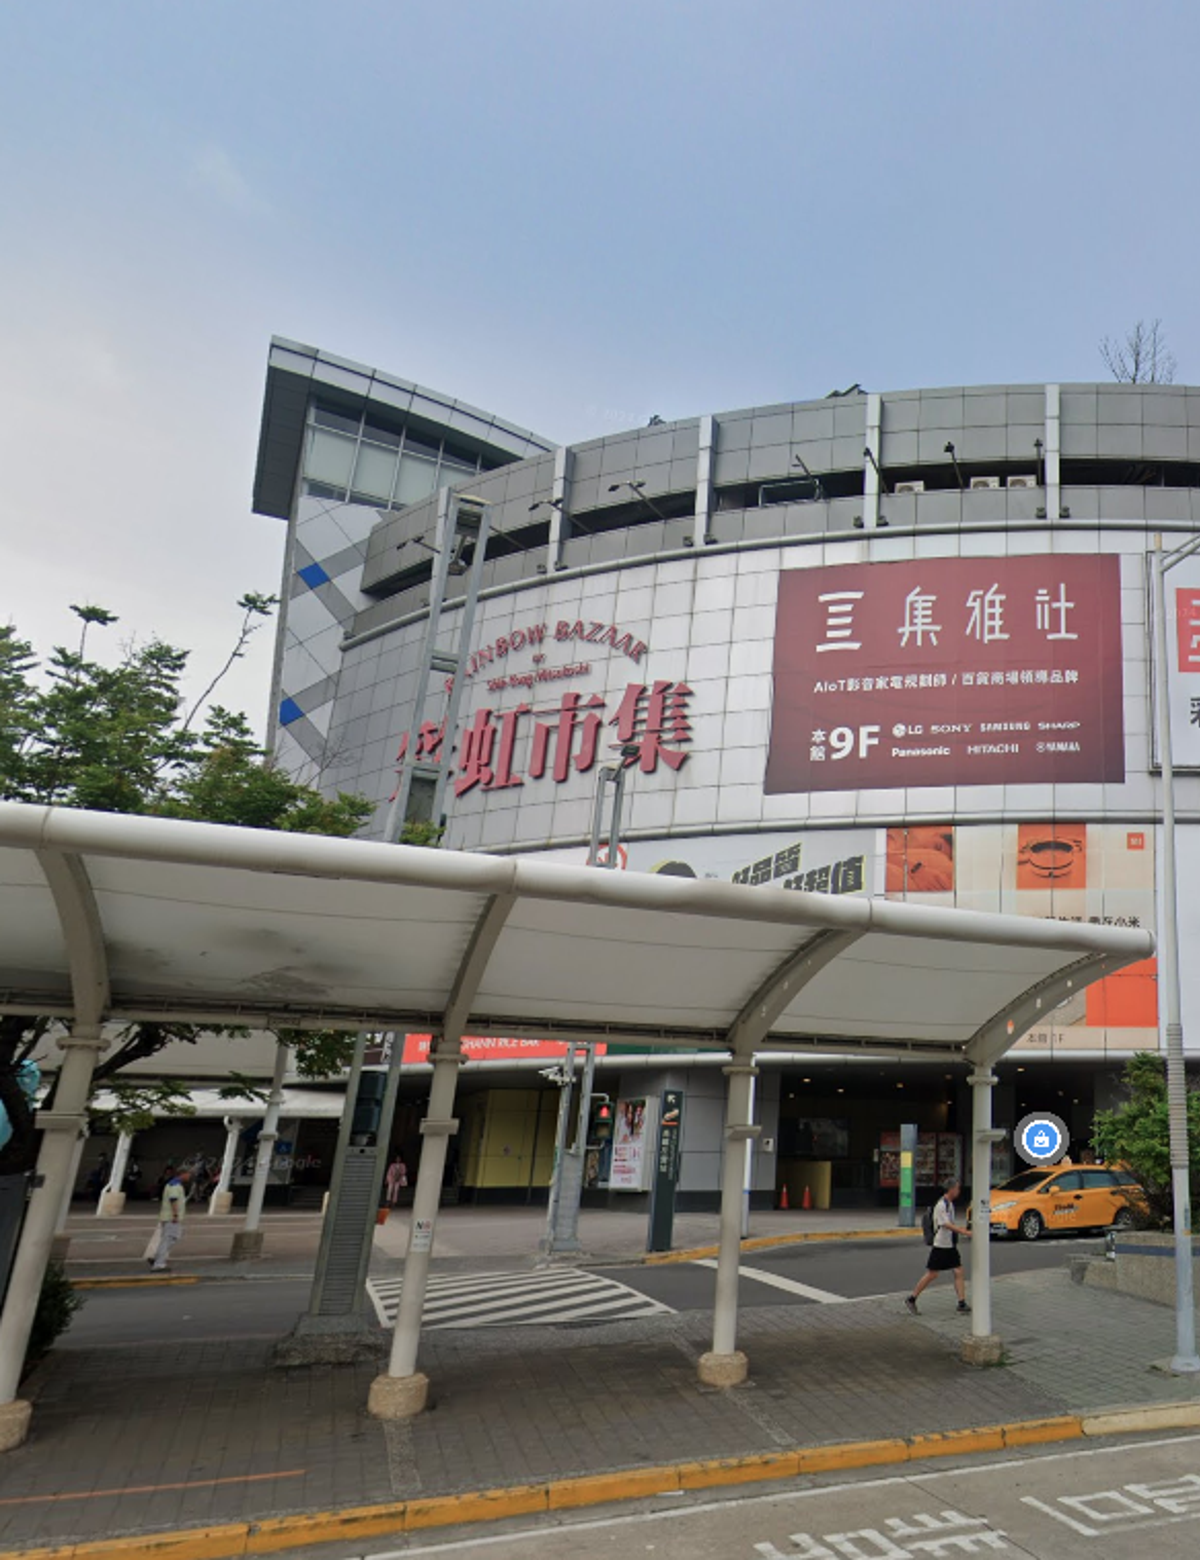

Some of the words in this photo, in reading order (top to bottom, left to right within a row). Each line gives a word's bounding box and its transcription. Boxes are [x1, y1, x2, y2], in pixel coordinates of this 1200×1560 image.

[554, 619, 648, 664] BAZAAR
[907, 725, 923, 735] LG
[931, 724, 973, 733] SONY
[828, 725, 881, 760] 9F
[892, 745, 950, 757] Panasonic
[967, 743, 1019, 755] HITACHI
